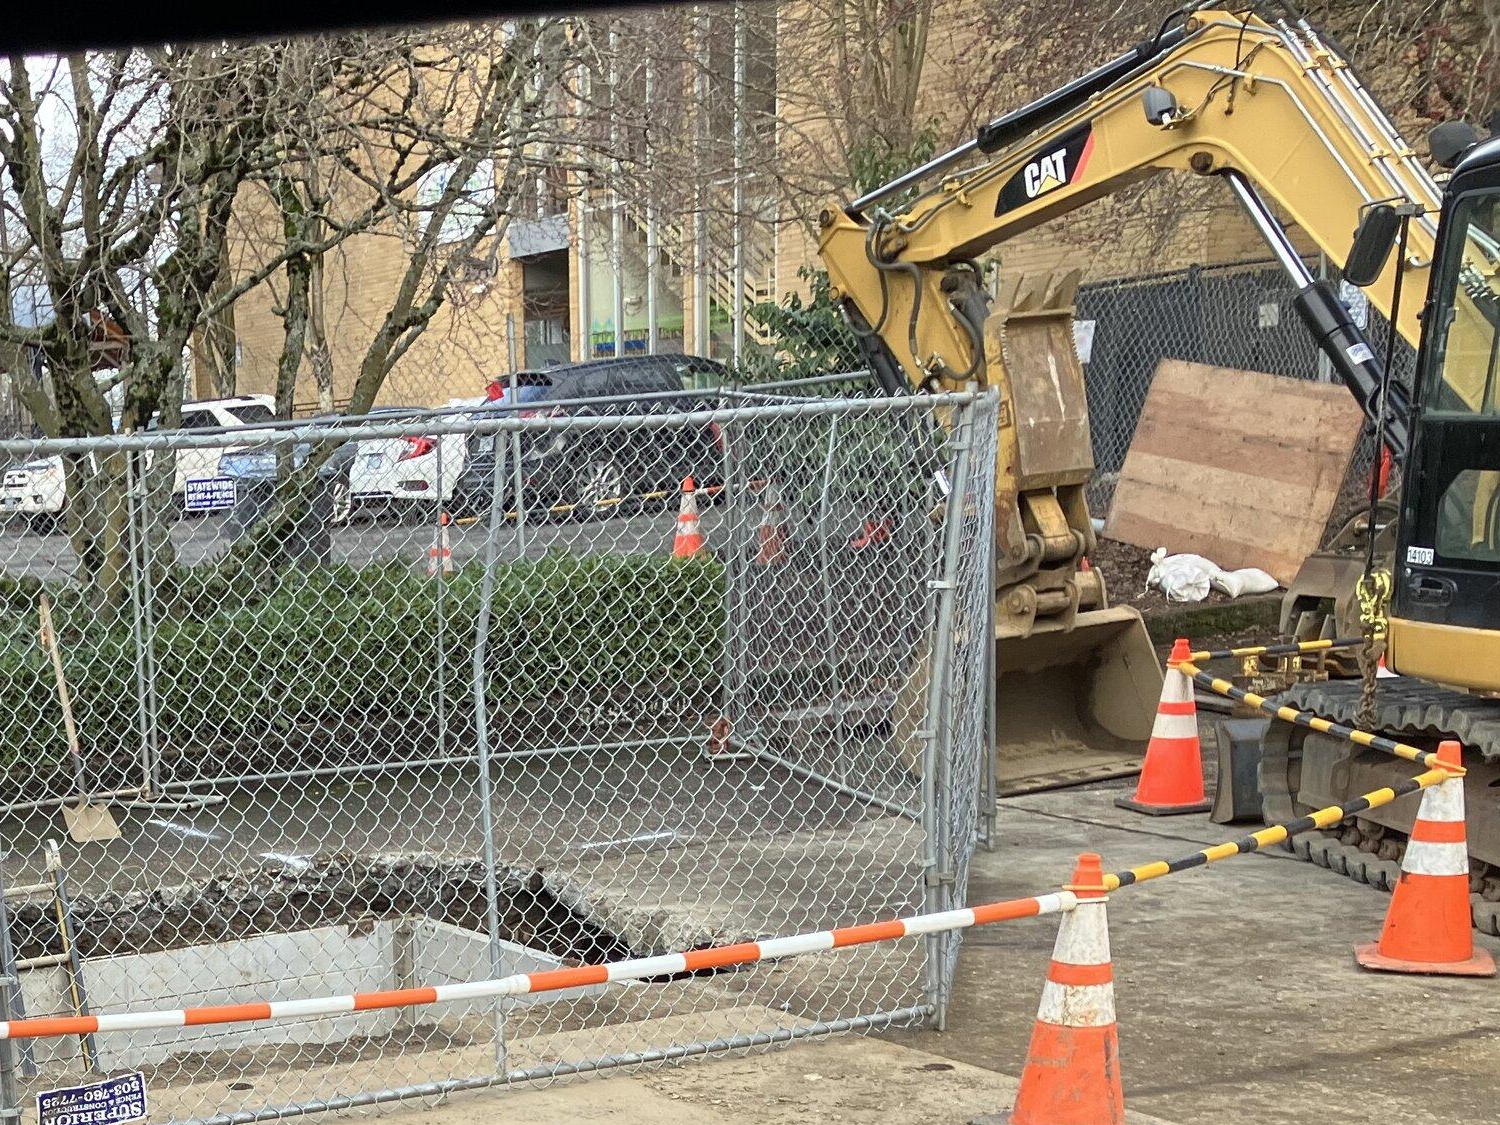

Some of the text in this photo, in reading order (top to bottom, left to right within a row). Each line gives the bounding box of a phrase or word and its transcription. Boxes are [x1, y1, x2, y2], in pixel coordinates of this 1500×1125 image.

[1024, 148, 1067, 198] CAT
[187, 480, 234, 492] STATEWIDE
[41, 1080, 140, 1110] 503-760-7725
[114, 1092, 142, 1105] FENCE
[41, 1101, 107, 1118] CONSTRUCTION
